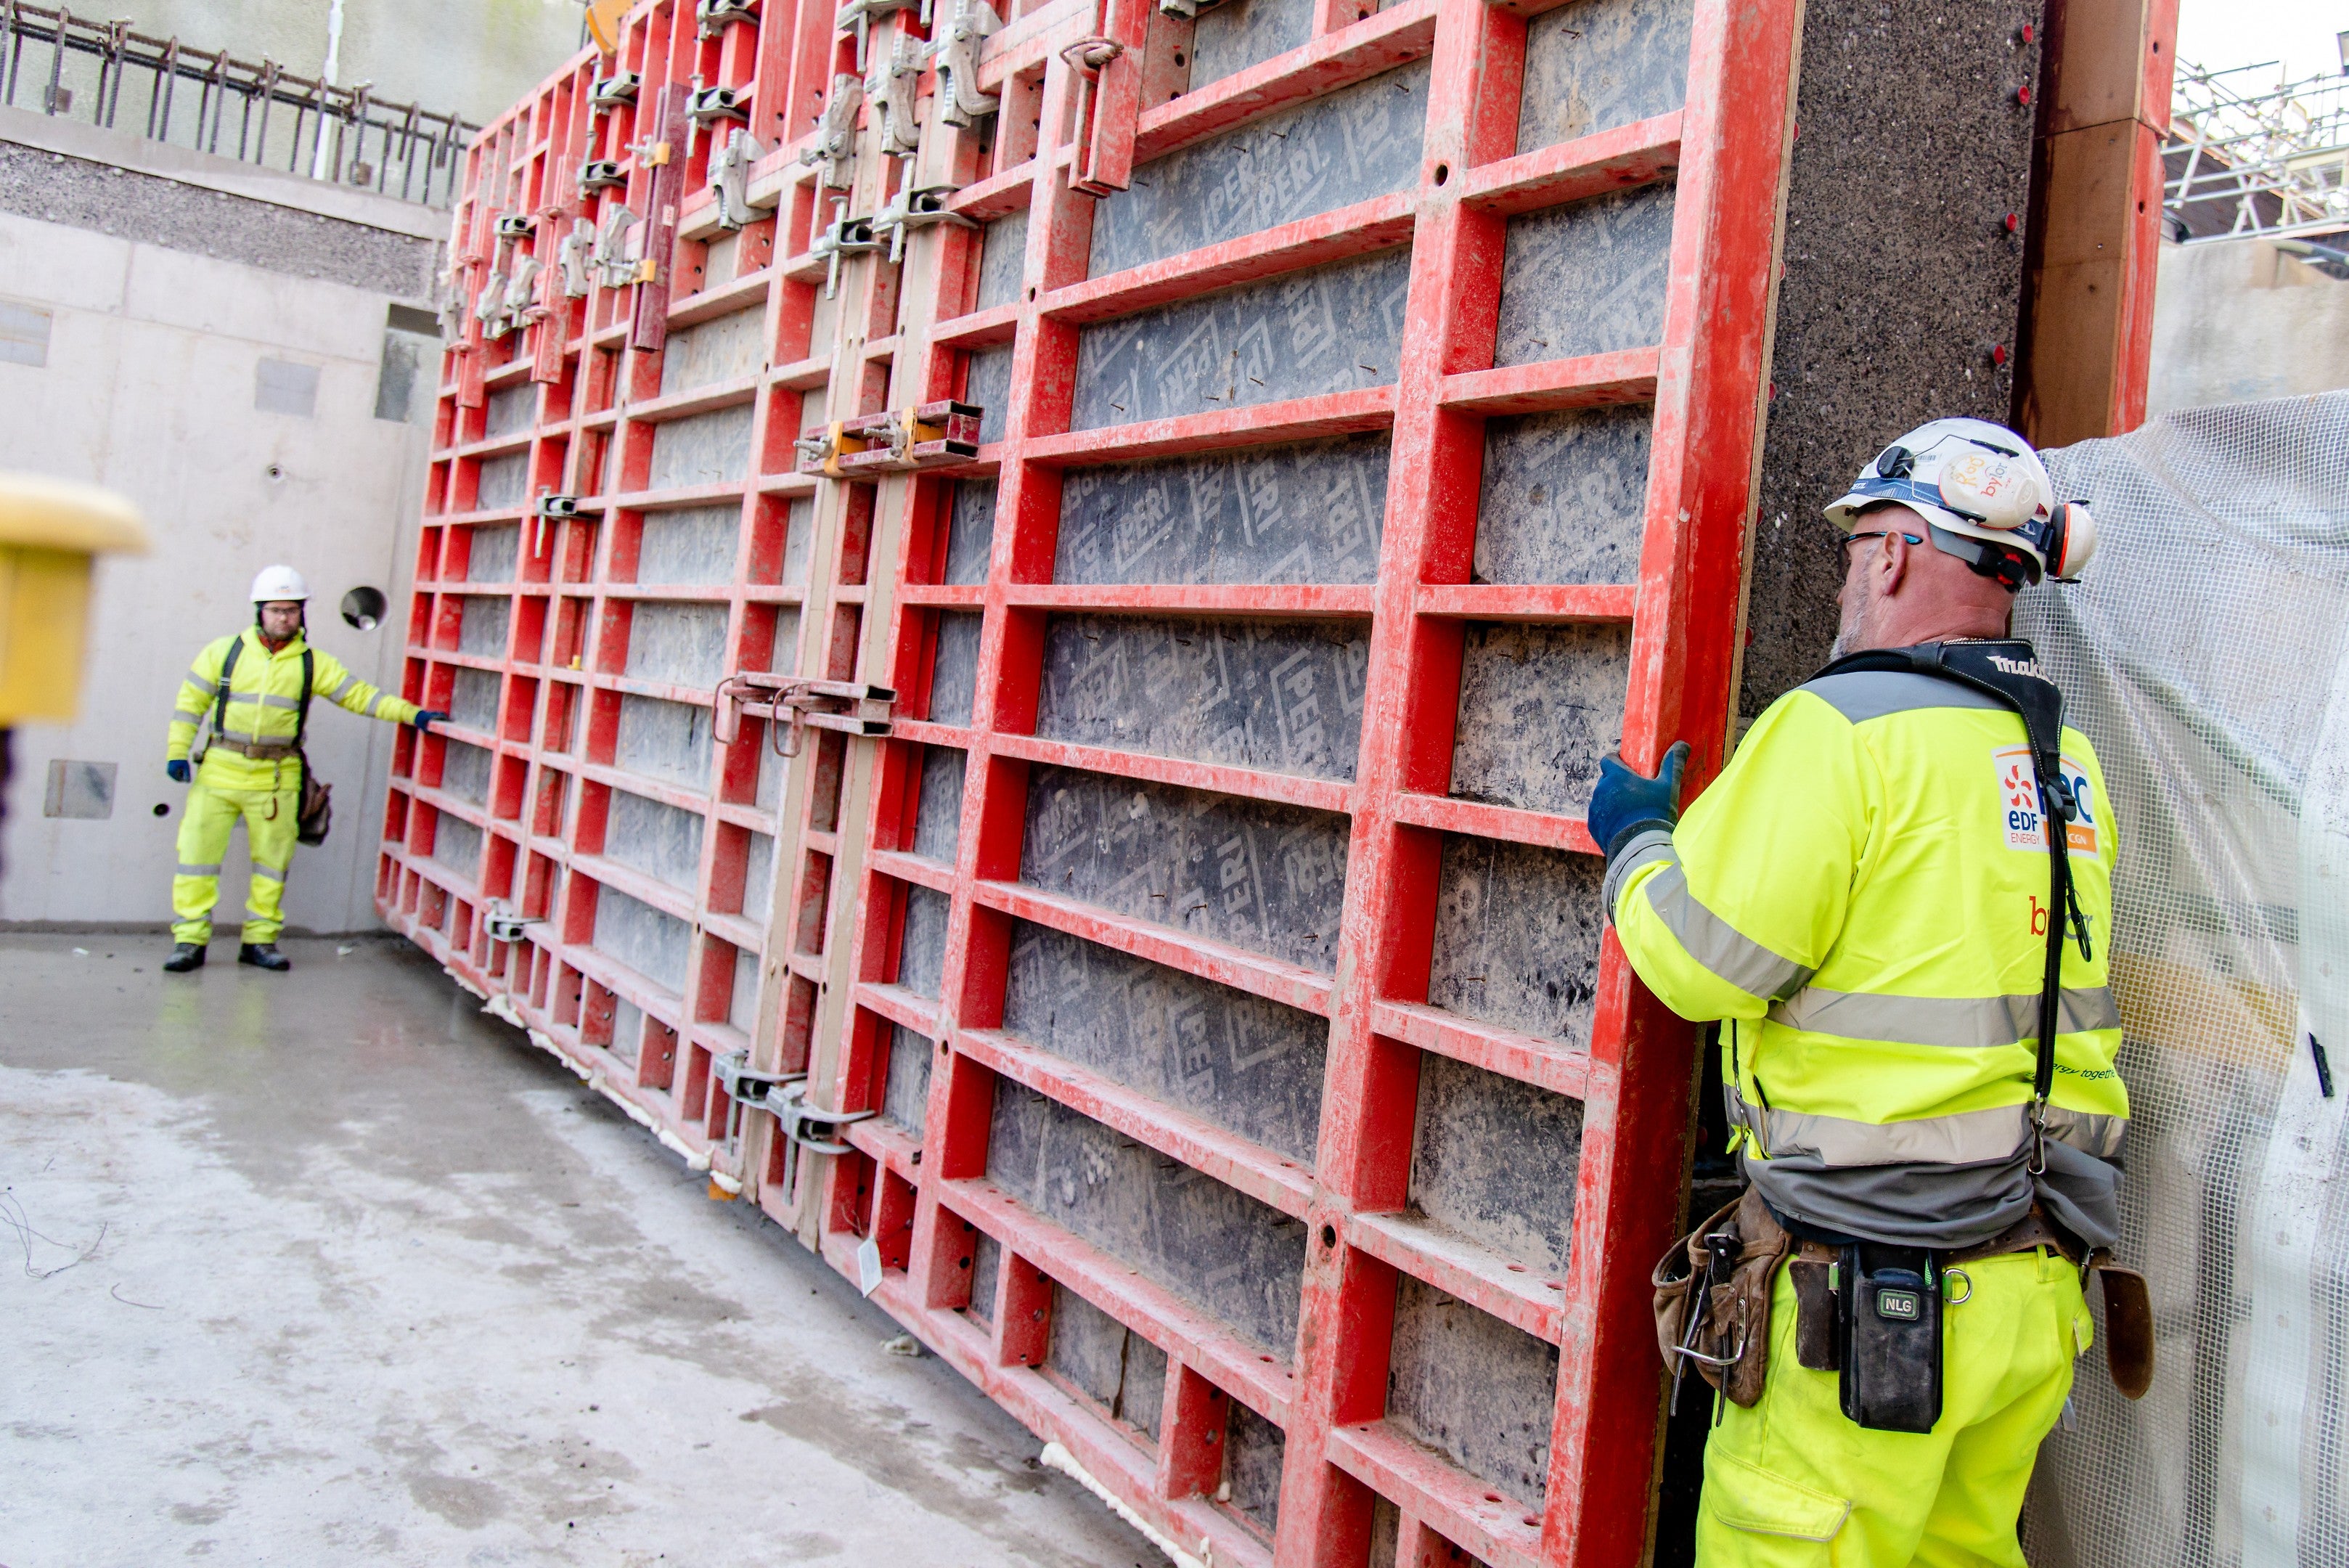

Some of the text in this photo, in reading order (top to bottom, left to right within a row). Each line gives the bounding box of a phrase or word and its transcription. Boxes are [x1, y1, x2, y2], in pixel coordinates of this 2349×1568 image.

[1208, 154, 1257, 225] PER
[1980, 462, 2008, 497] bylor
[1284, 666, 1325, 758] PER
[2011, 833, 2040, 845] ENERGY
[1180, 1011, 1216, 1099] PER
[1886, 1298, 1912, 1312] NLG
